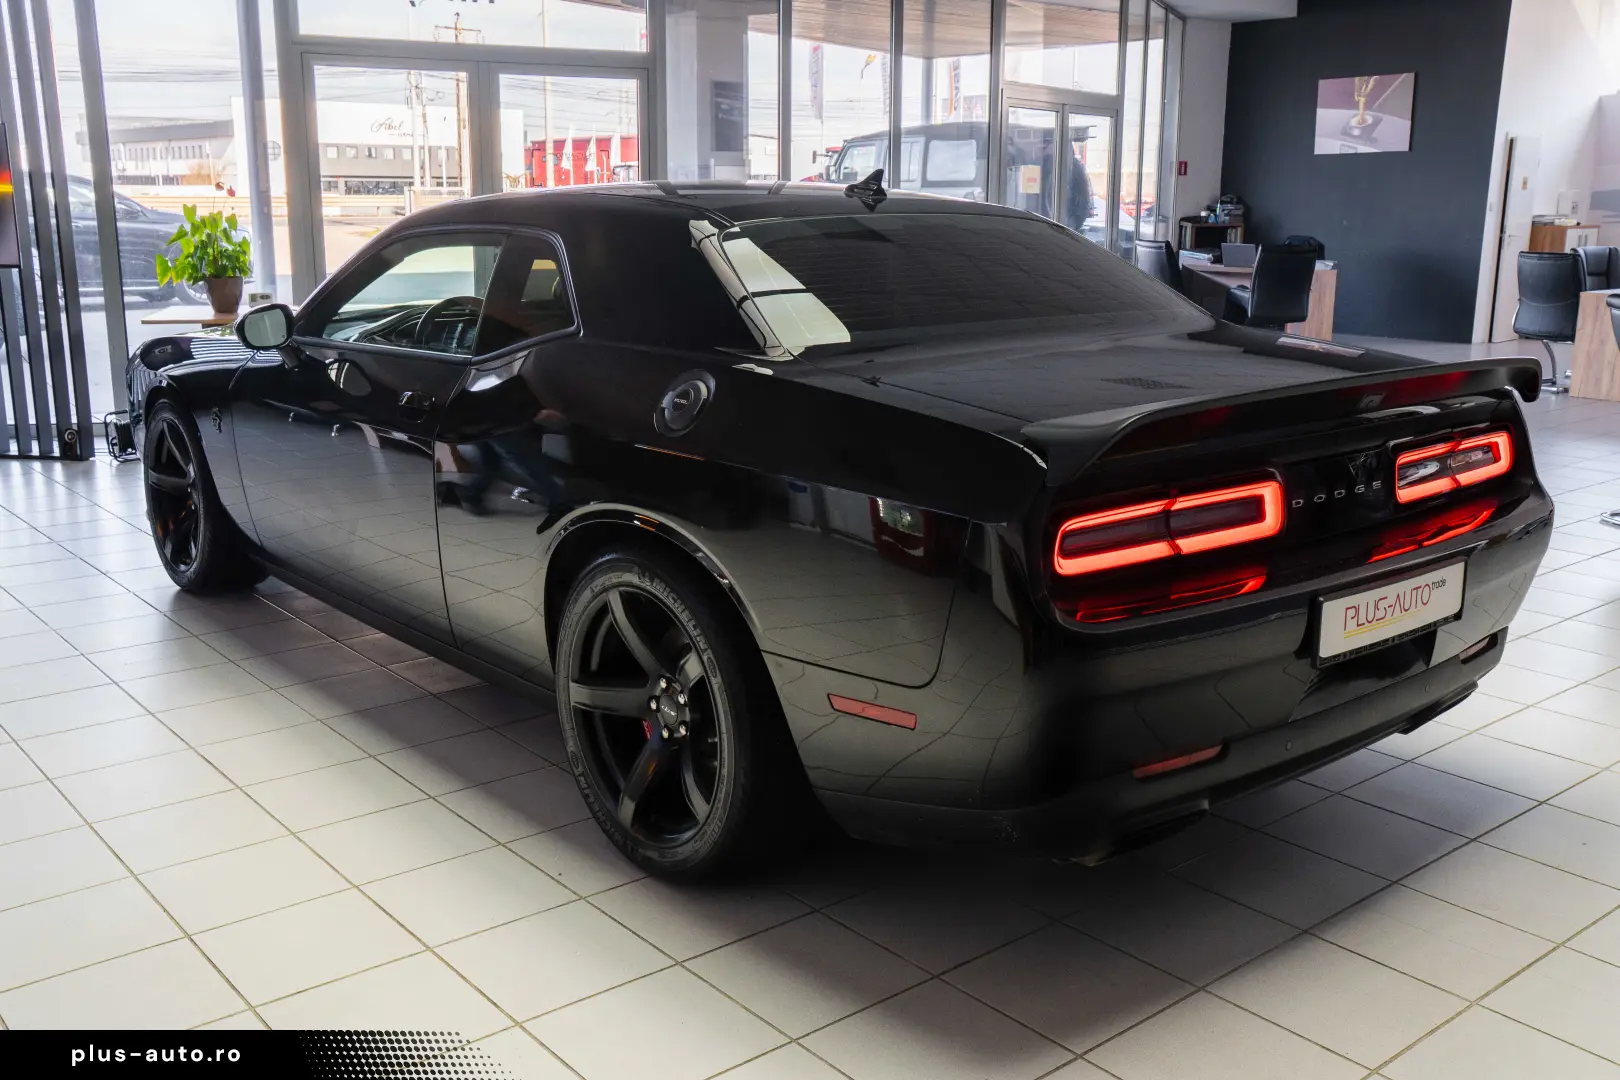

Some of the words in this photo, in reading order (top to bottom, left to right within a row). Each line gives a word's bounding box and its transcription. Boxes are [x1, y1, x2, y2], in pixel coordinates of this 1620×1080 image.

[1292, 481, 1382, 508] DODGE
[652, 577, 710, 657] MICHELIN
[1343, 583, 1431, 631] PLUS-AUTO
[1431, 577, 1447, 591] trade
